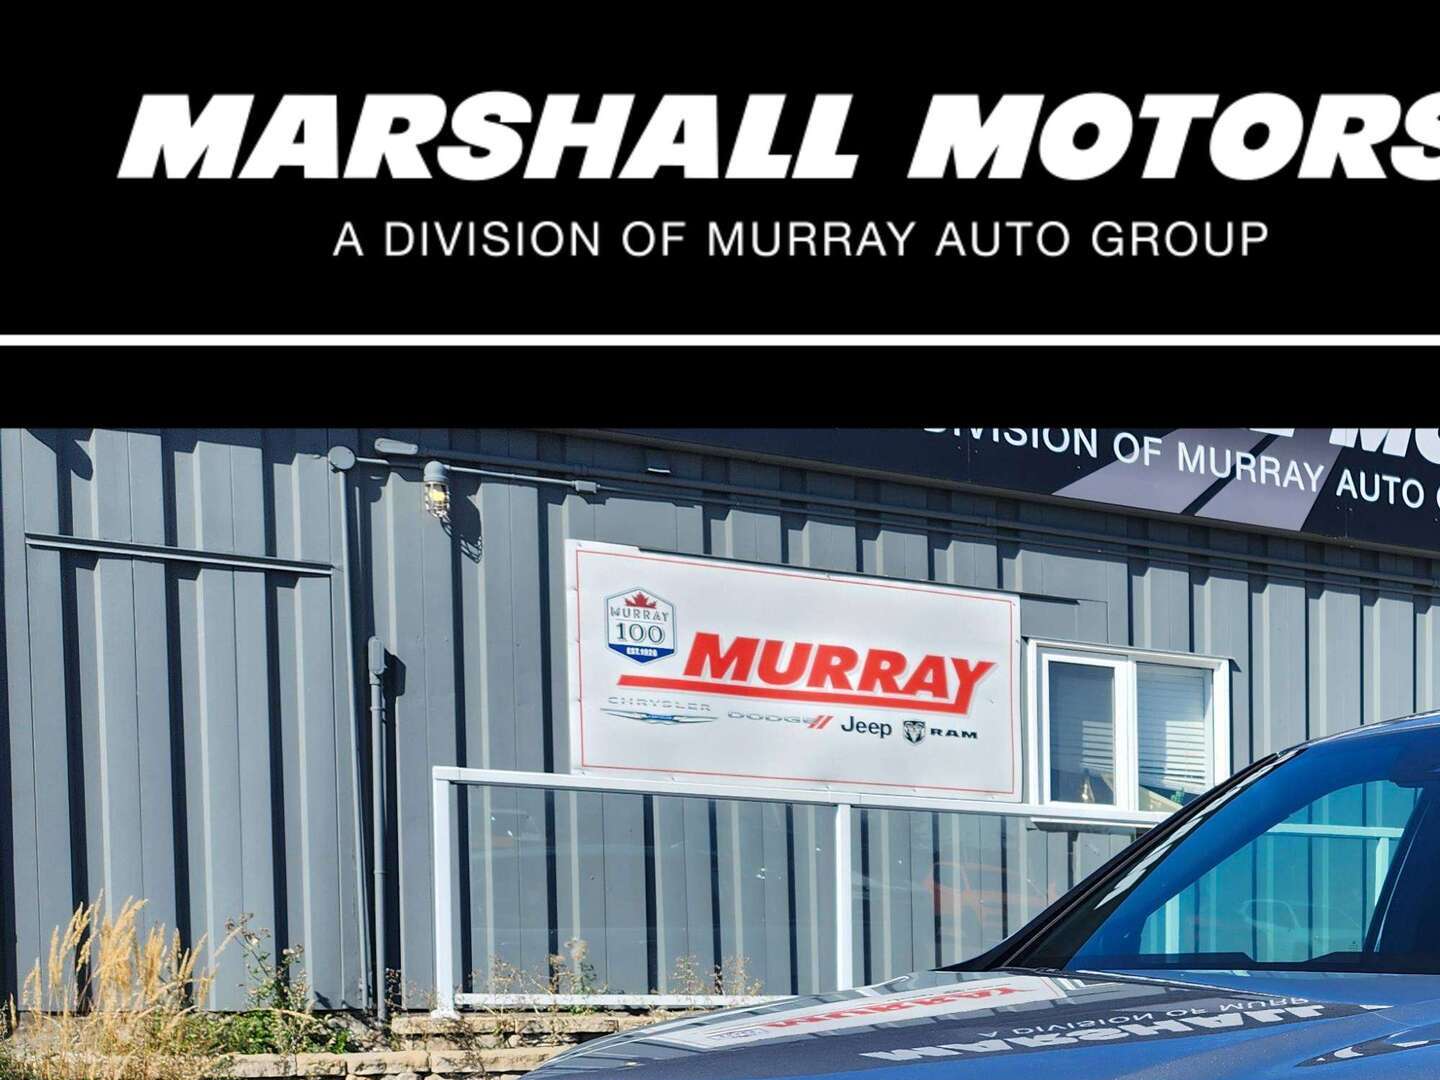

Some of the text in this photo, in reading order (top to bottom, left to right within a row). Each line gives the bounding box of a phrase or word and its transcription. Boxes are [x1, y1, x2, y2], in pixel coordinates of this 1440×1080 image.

[1113, 432, 1162, 466] OF
[1178, 442, 1325, 493] MURRAY
[1336, 468, 1424, 509] AUTO
[610, 606, 669, 622] MURRAY
[616, 622, 666, 646] 100
[682, 631, 998, 704] MURRAY
[841, 715, 892, 738] Jeep
[930, 727, 978, 740] RAM
